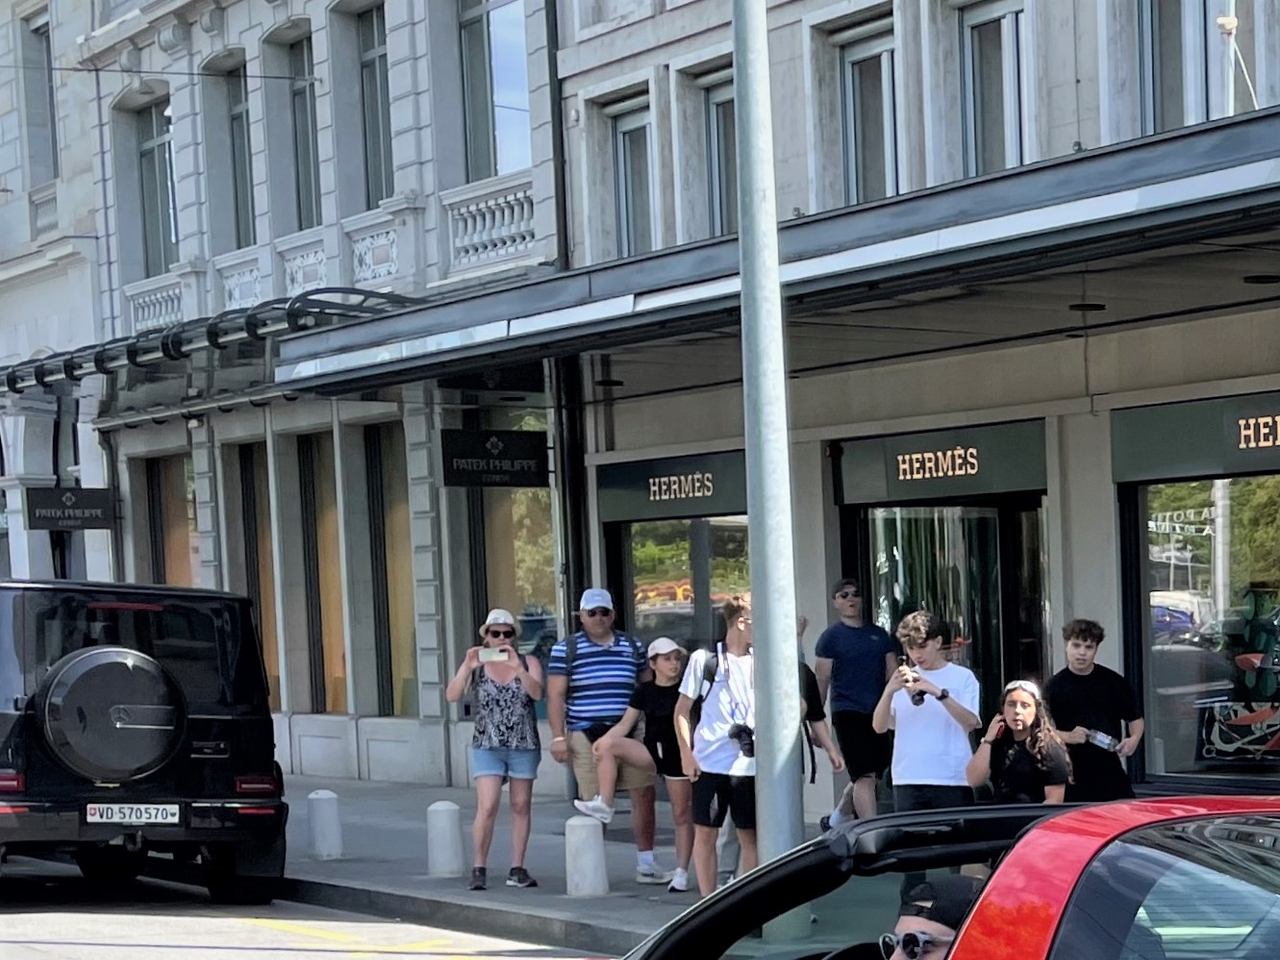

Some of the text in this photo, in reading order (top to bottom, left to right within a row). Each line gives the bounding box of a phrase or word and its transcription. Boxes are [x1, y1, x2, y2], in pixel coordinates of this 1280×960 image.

[453, 458, 538, 472] PATEK PHILIPPE
[896, 445, 979, 481] HERMÈS
[648, 470, 714, 501] HERMÈS
